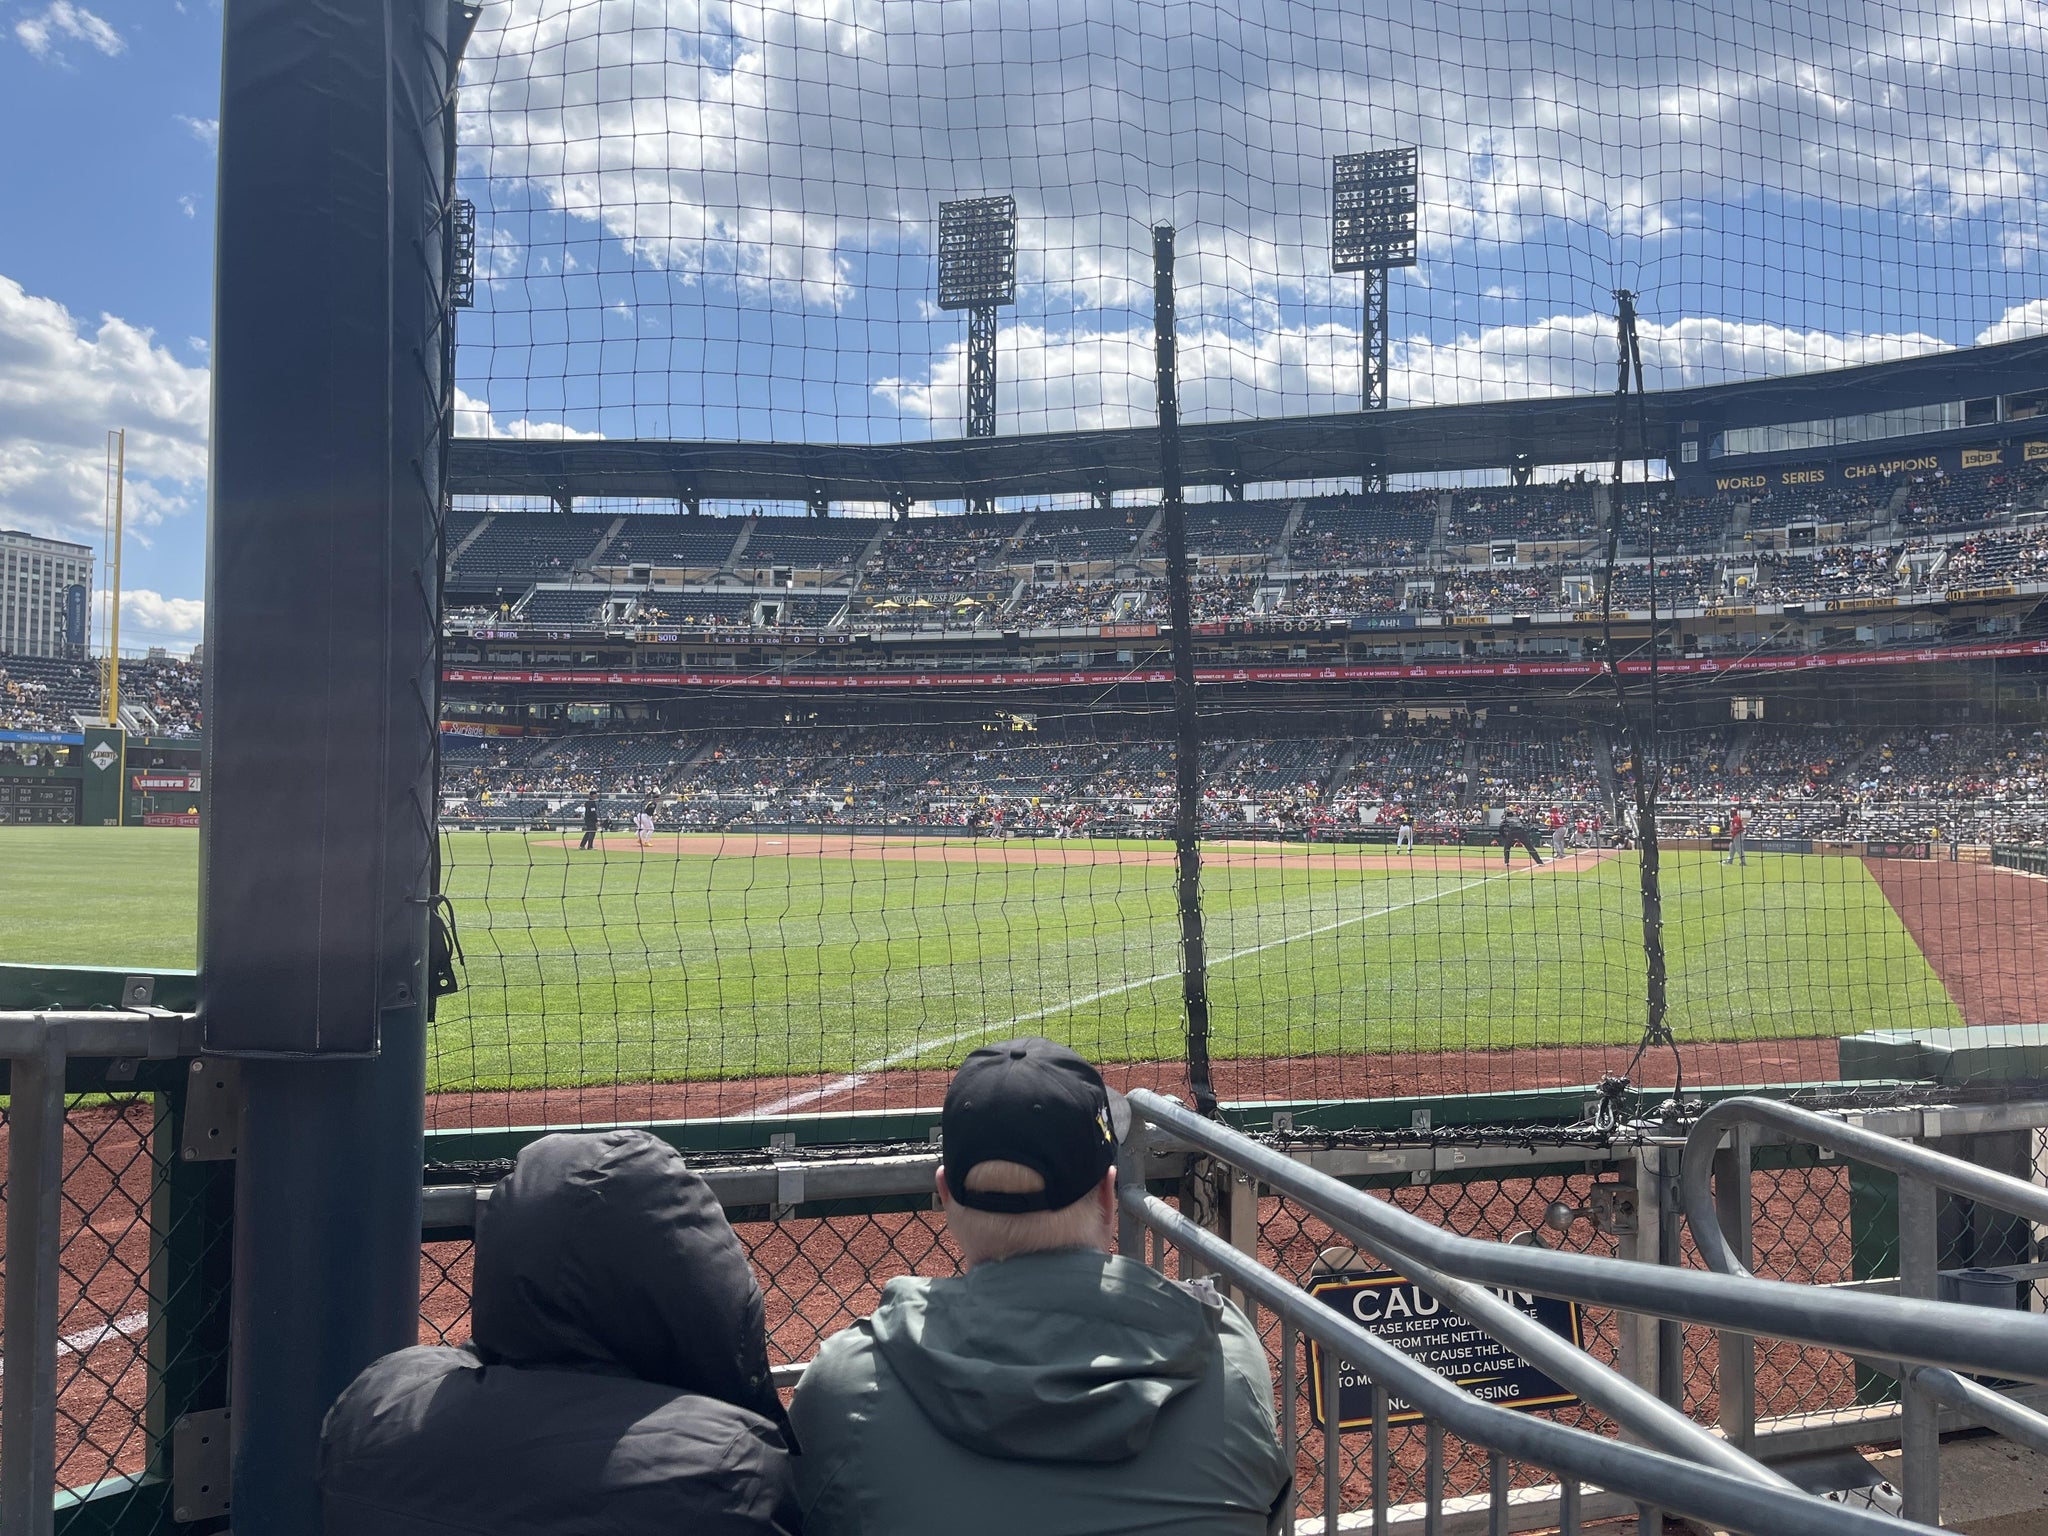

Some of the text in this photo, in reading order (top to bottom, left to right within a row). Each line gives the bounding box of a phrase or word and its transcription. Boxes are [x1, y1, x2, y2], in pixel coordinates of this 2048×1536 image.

[1965, 453, 1993, 464] 1909
[1716, 456, 1938, 490] WORLD SERIES CHAMPIONS
[1379, 619, 1401, 627] AHN
[658, 634, 678, 642] SOTO
[450, 723, 483, 735] Surfside
[1362, 1322, 1403, 1335] EASE
[1406, 1318, 1439, 1331] KEEP
[1385, 1330, 1491, 1349] ROM THE NETTI
[1408, 1352, 1427, 1363] AY
[1430, 1347, 1473, 1361] CAUSE
[1474, 1344, 1500, 1356] THE
[1430, 1363, 1471, 1377] OULD
[1473, 1358, 1515, 1372] CAUSE
